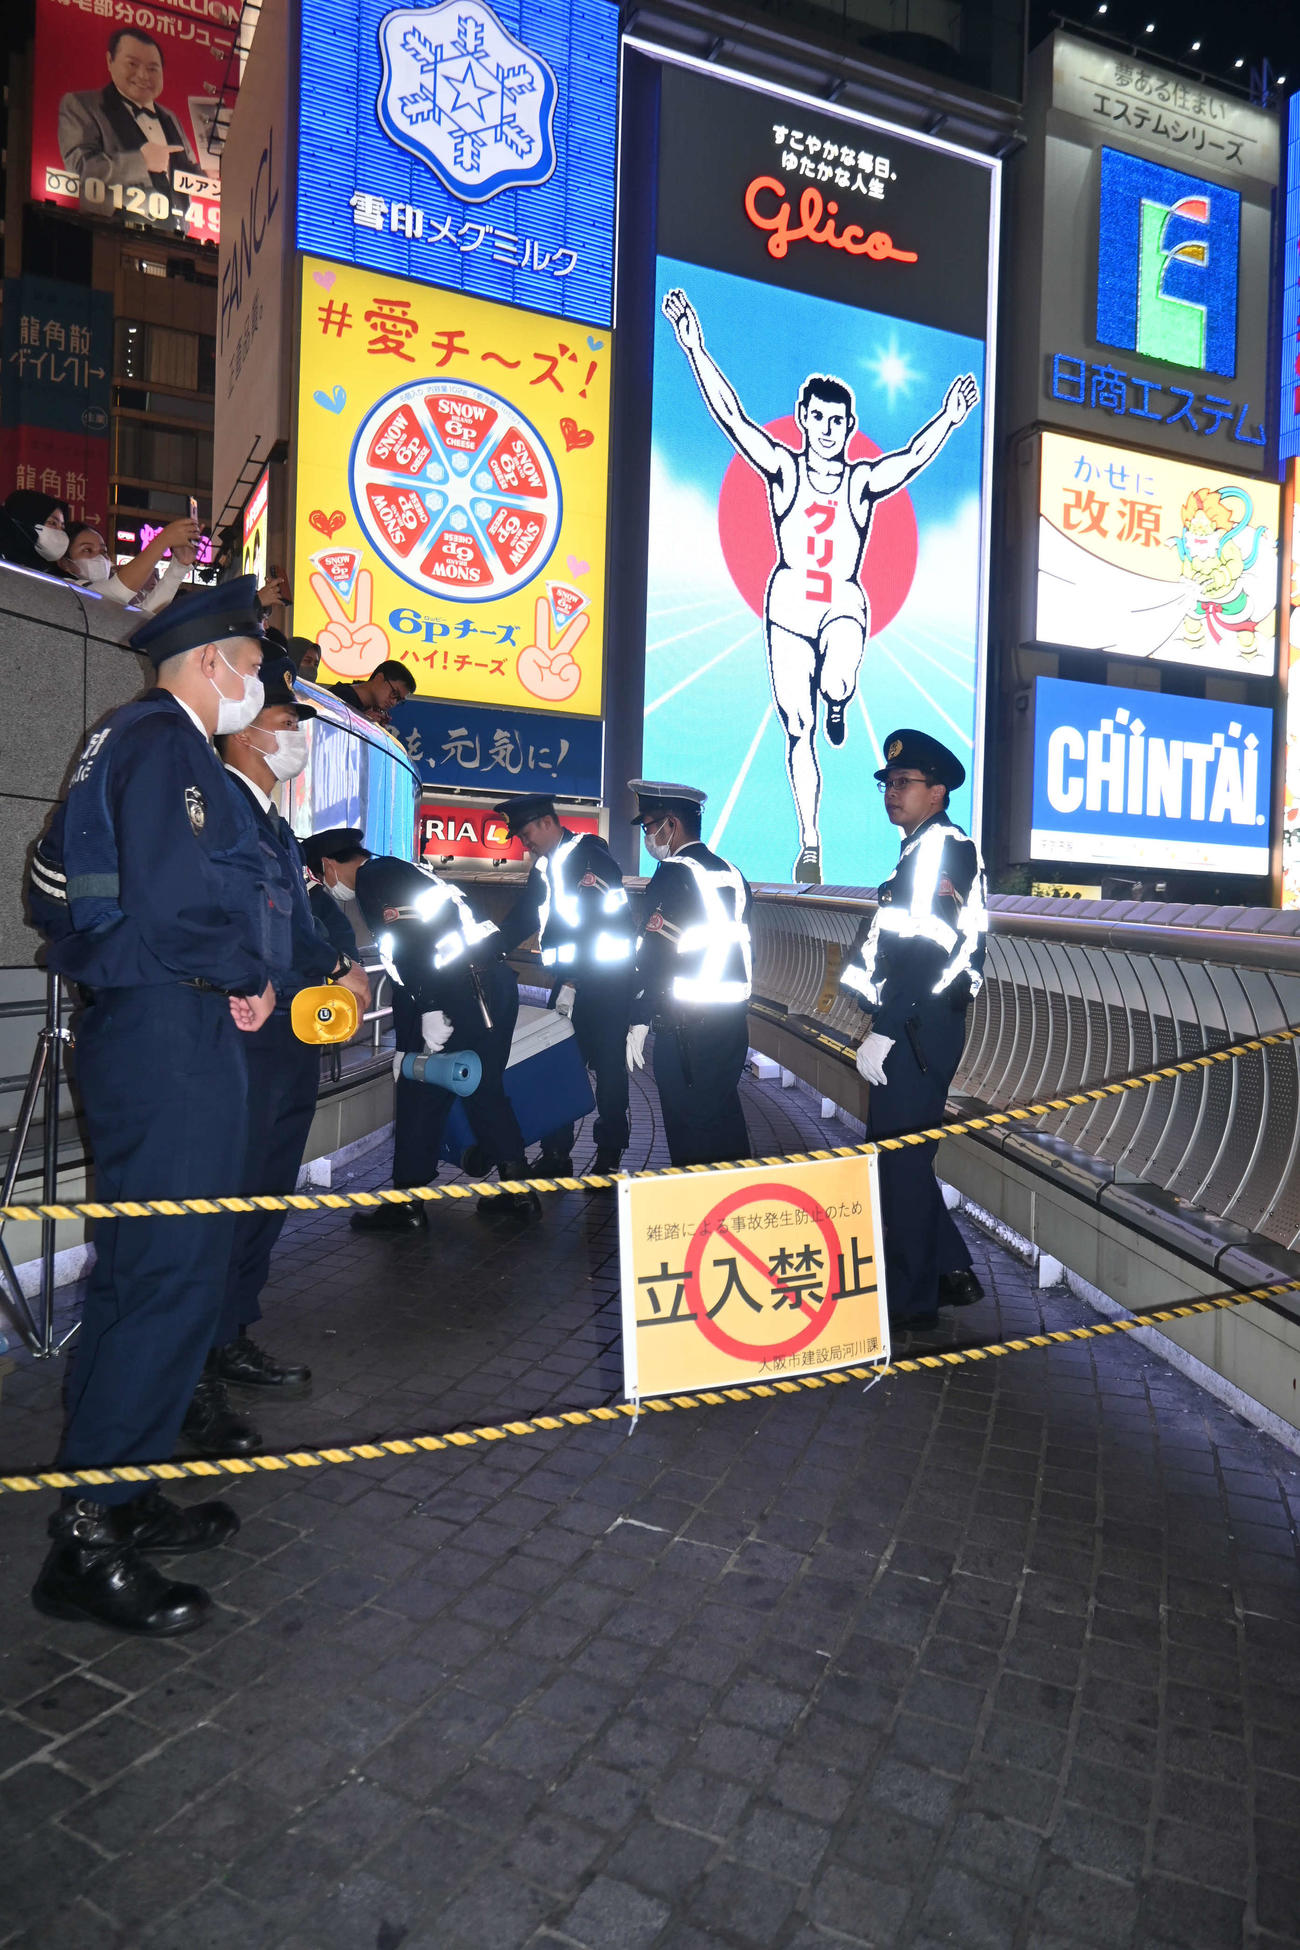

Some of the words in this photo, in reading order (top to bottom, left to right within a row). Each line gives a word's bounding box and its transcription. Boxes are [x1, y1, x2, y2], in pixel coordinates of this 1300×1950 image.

[1114, 63, 1227, 120] 夢ある住まい
[1092, 93, 1245, 165] エステムシリーズ
[781, 150, 885, 200] ゆたかな人生
[220, 125, 279, 357] FANCL
[349, 191, 578, 276] 雪印メグミルク
[744, 175, 919, 263] Glico
[19, 315, 93, 356] 龍角散
[438, 399, 488, 422] SNOW
[1052, 352, 1266, 447] 日商エステム
[374, 412, 410, 460] SNOW
[16, 463, 88, 503] 龍角散
[511, 439, 543, 488] SNOW
[371, 495, 405, 544] SNOW
[1062, 487, 1163, 548] 改源
[508, 521, 540, 567] SNOW
[804, 499, 839, 604] グリコ
[432, 561, 481, 582] SNOW
[420, 818, 479, 843] RIA
[646, 1200, 863, 1242] 雑踏による事故発生防止のため
[636, 1236, 878, 1328] 立入禁止
[758, 1336, 879, 1374] 大阪市建設局河川課
